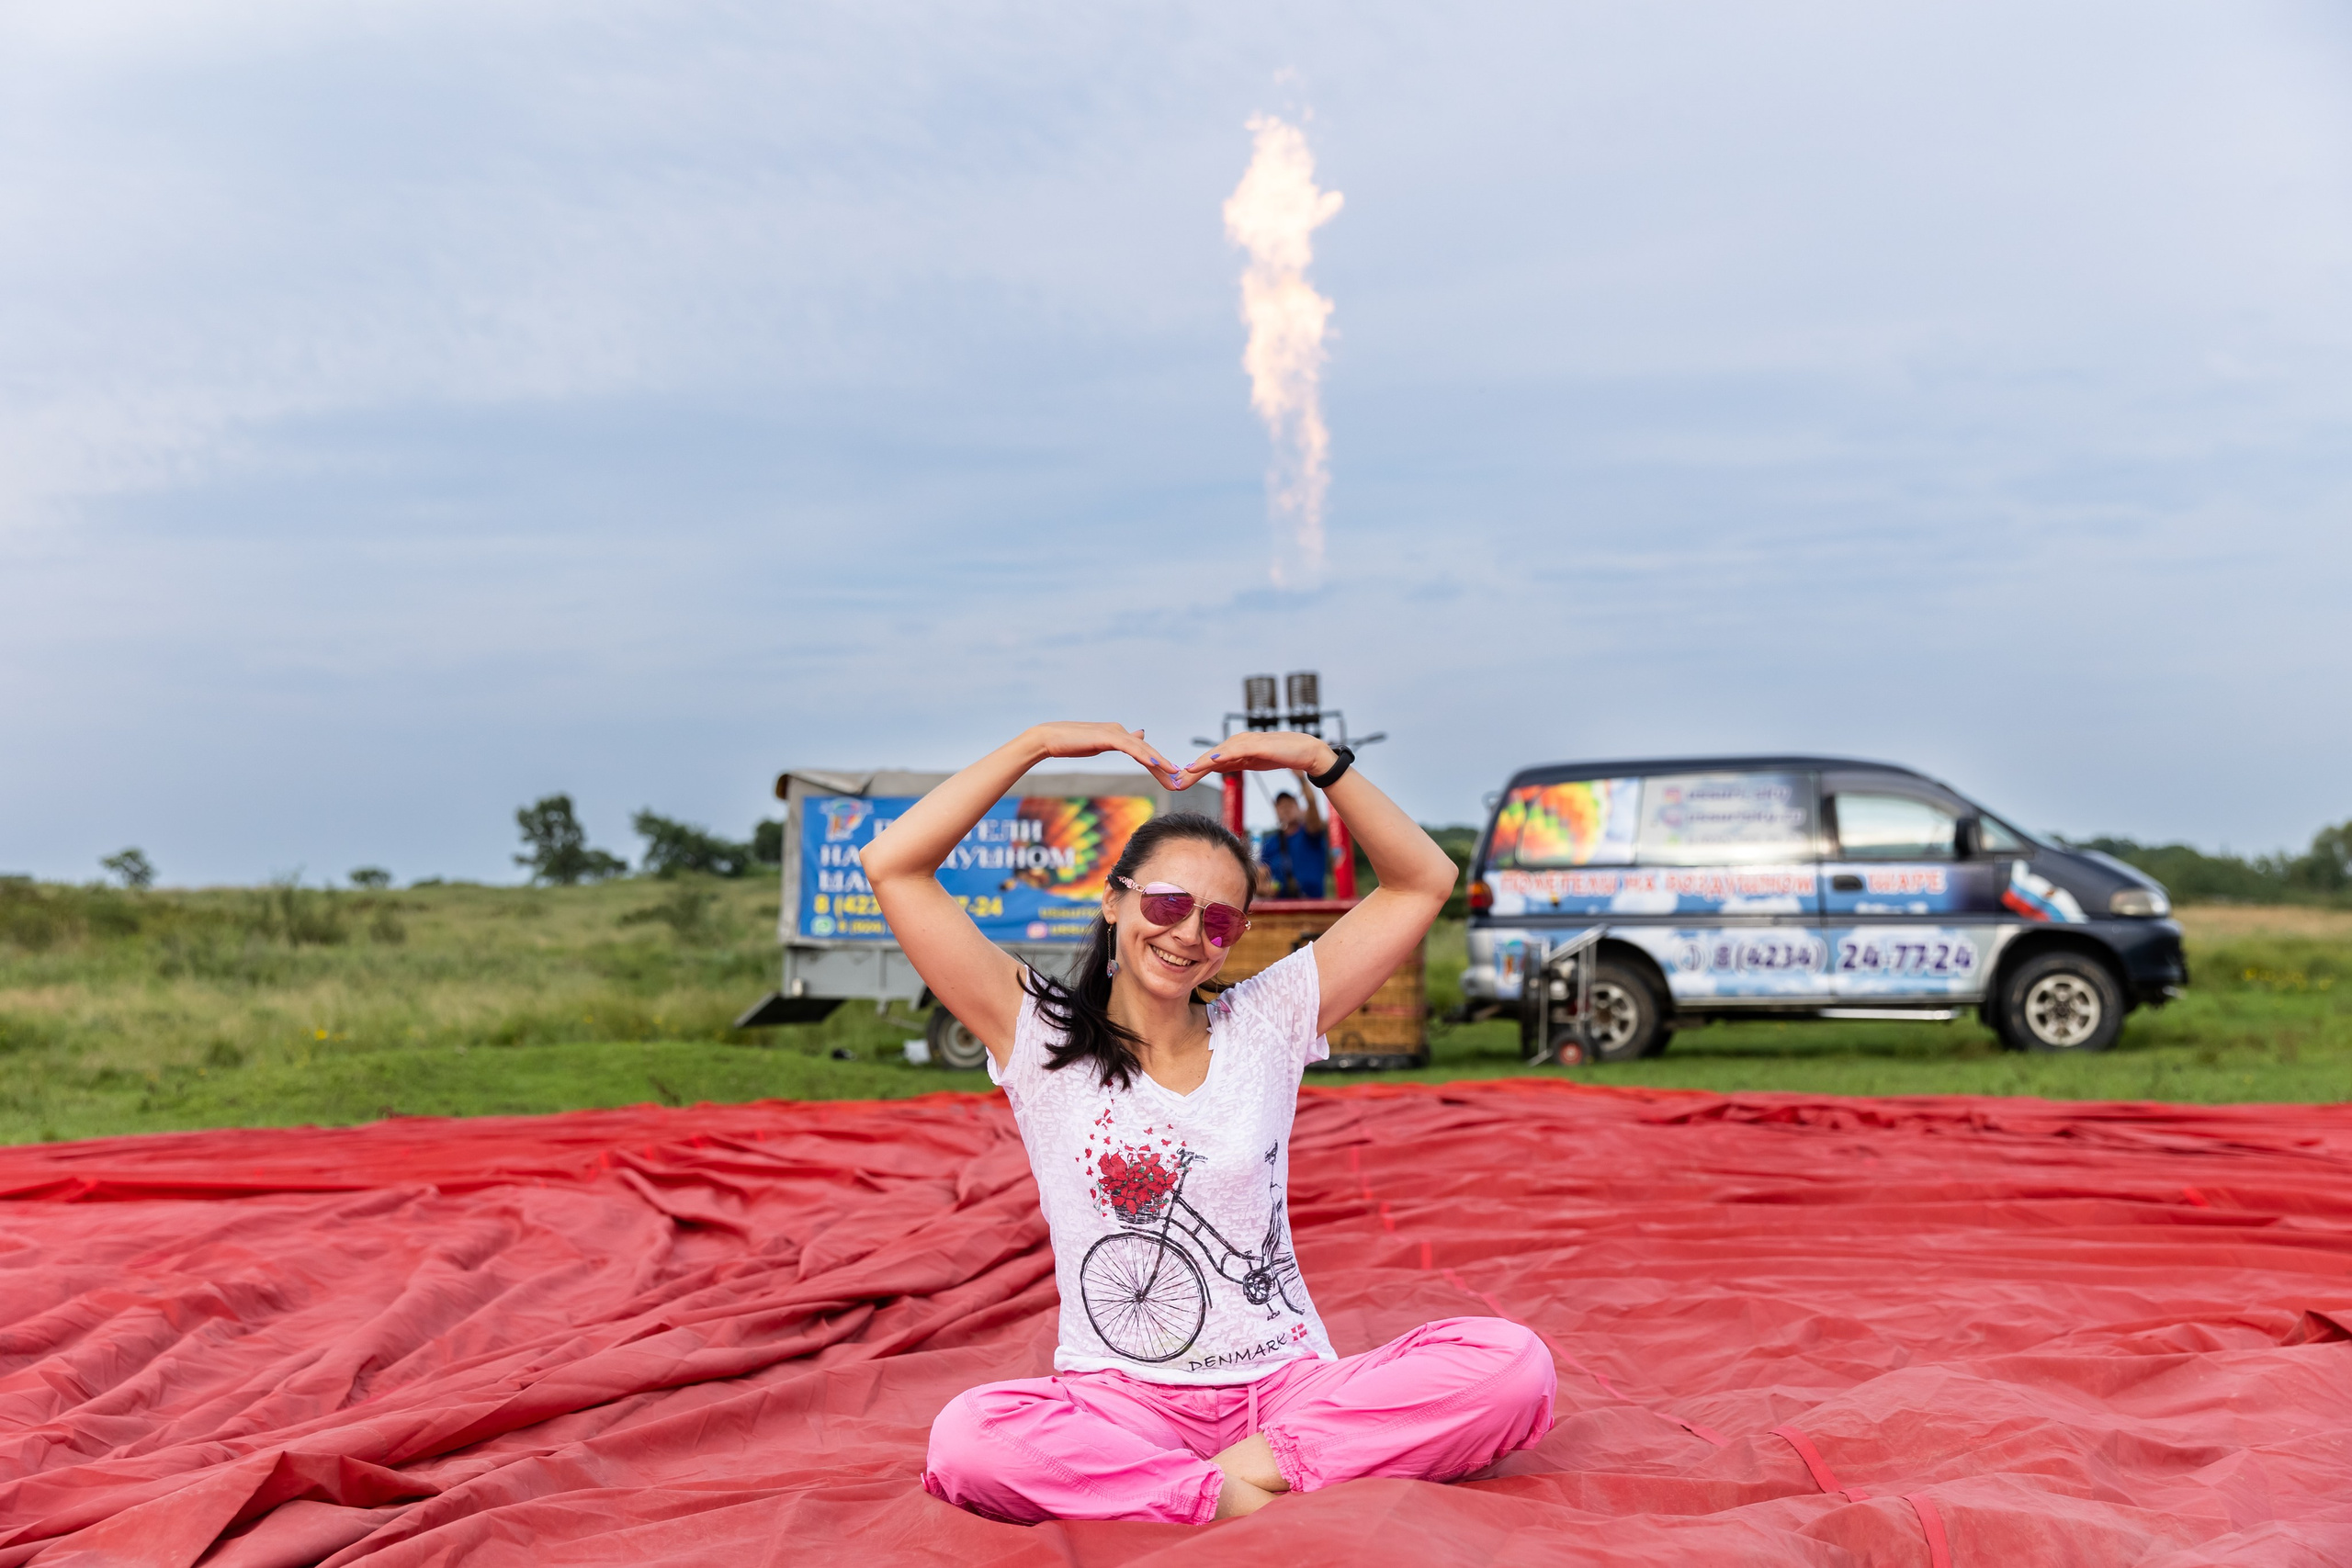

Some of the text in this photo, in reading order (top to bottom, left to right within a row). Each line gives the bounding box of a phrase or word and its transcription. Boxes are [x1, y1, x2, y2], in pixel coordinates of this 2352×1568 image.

[939, 845, 1076, 870] ДУШНОМ
[1869, 871, 1946, 894] ШАРЕ
[1188, 1332, 1288, 1371] DENMARK
